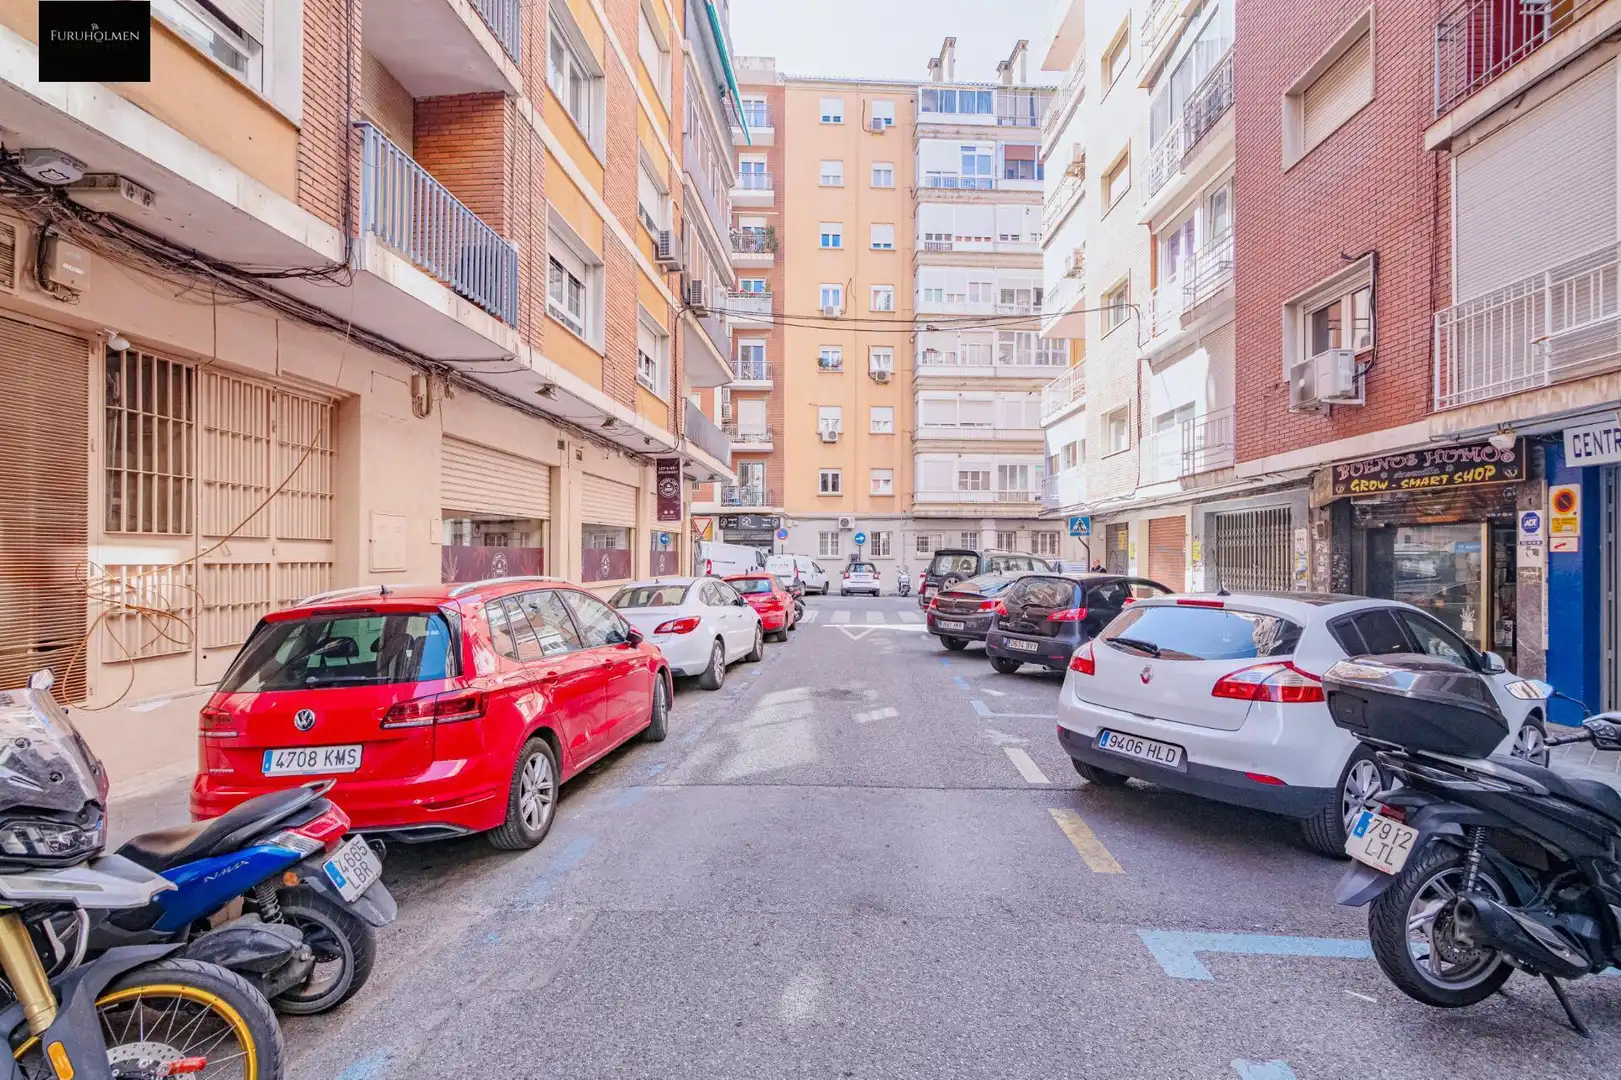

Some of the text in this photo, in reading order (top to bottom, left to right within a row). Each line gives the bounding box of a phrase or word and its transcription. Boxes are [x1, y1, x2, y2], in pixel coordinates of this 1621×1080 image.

[1573, 428, 1621, 457] CENTR
[1337, 453, 1418, 480] BUENOS
[1423, 445, 1515, 467] HUMOS
[1350, 478, 1388, 492] GROW
[1400, 474, 1449, 488] SMART
[1453, 464, 1496, 484] SHOP
[276, 749, 356, 769] 4708 KMS
[1109, 735, 1176, 763] 9406 HLD
[1368, 818, 1413, 850] 7912
[337, 841, 368, 873] 4665
[1364, 838, 1393, 866] LTL
[346, 861, 373, 889] LBR
